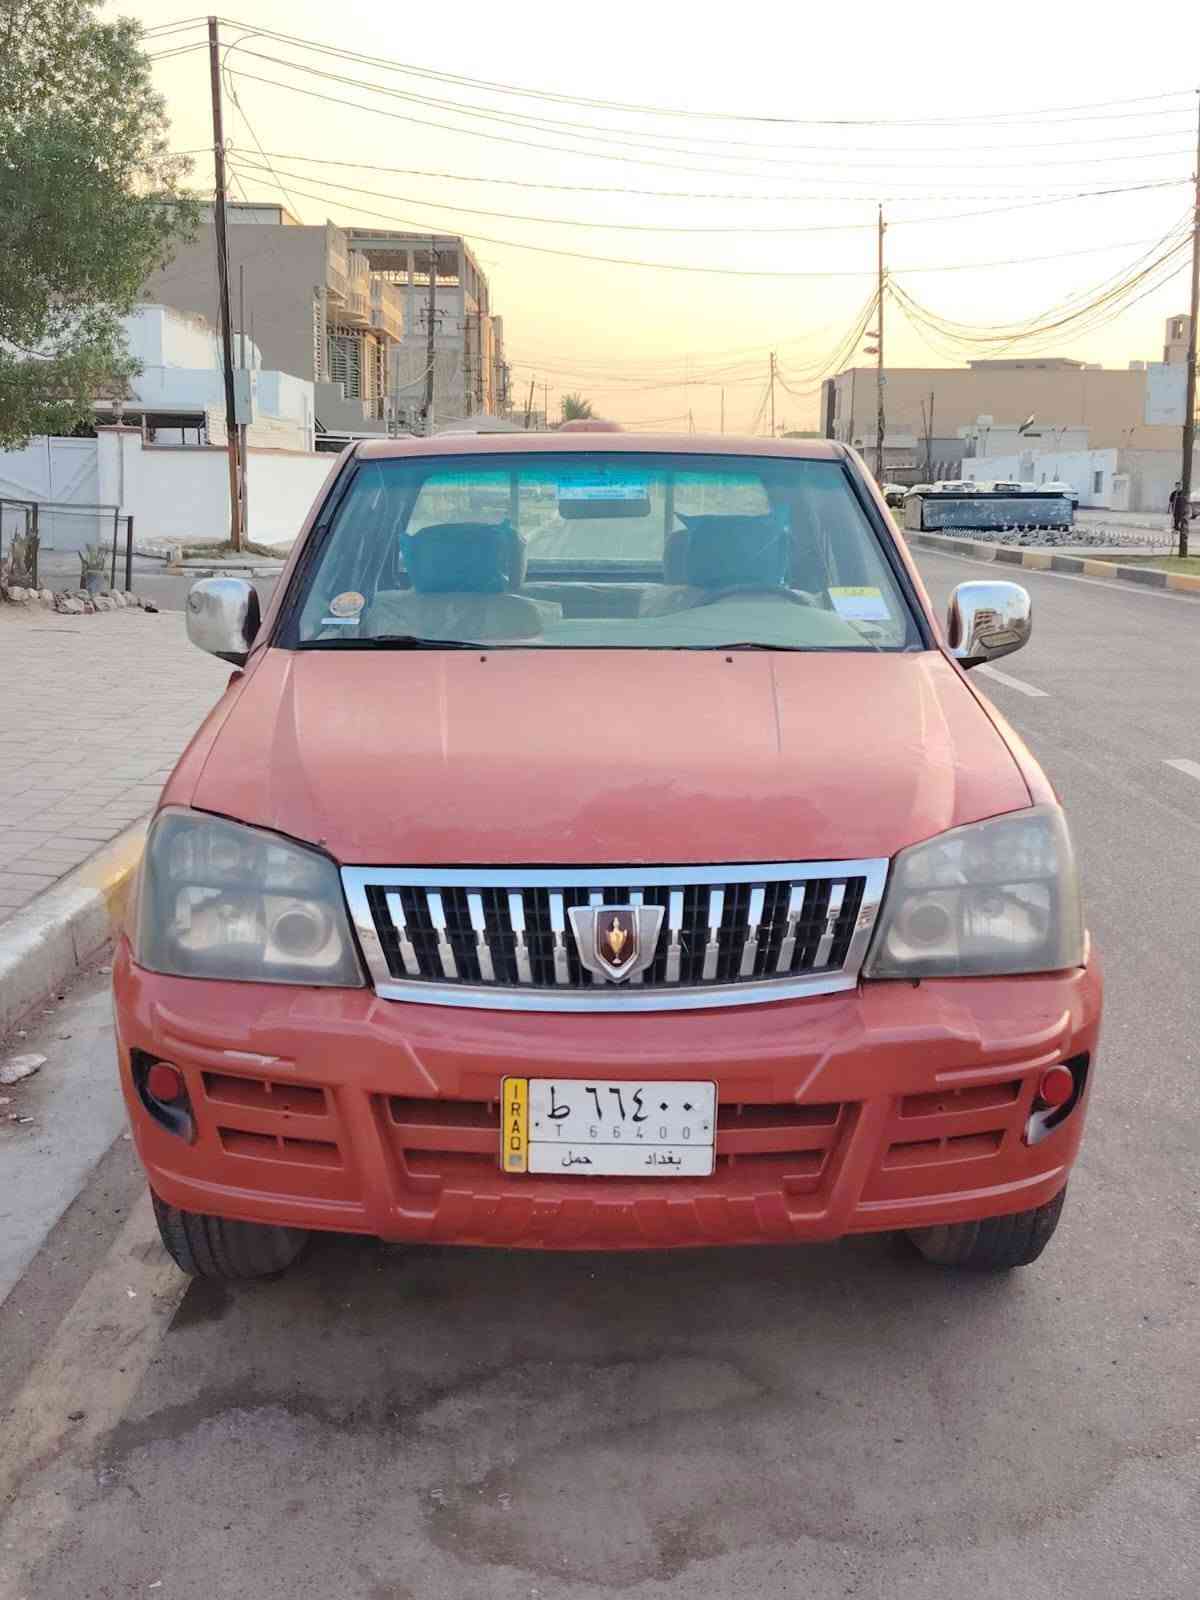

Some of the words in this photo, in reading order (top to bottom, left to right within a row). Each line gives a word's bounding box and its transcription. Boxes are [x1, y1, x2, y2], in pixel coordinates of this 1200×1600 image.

[546, 1085, 571, 1120] ط
[585, 1086, 694, 1122] ٦٦٤٠٠
[510, 1084, 521, 1150] IRAQ
[588, 1124, 692, 1140] 66400
[561, 1150, 593, 1167] حمل
[644, 1150, 682, 1170] بغداد
